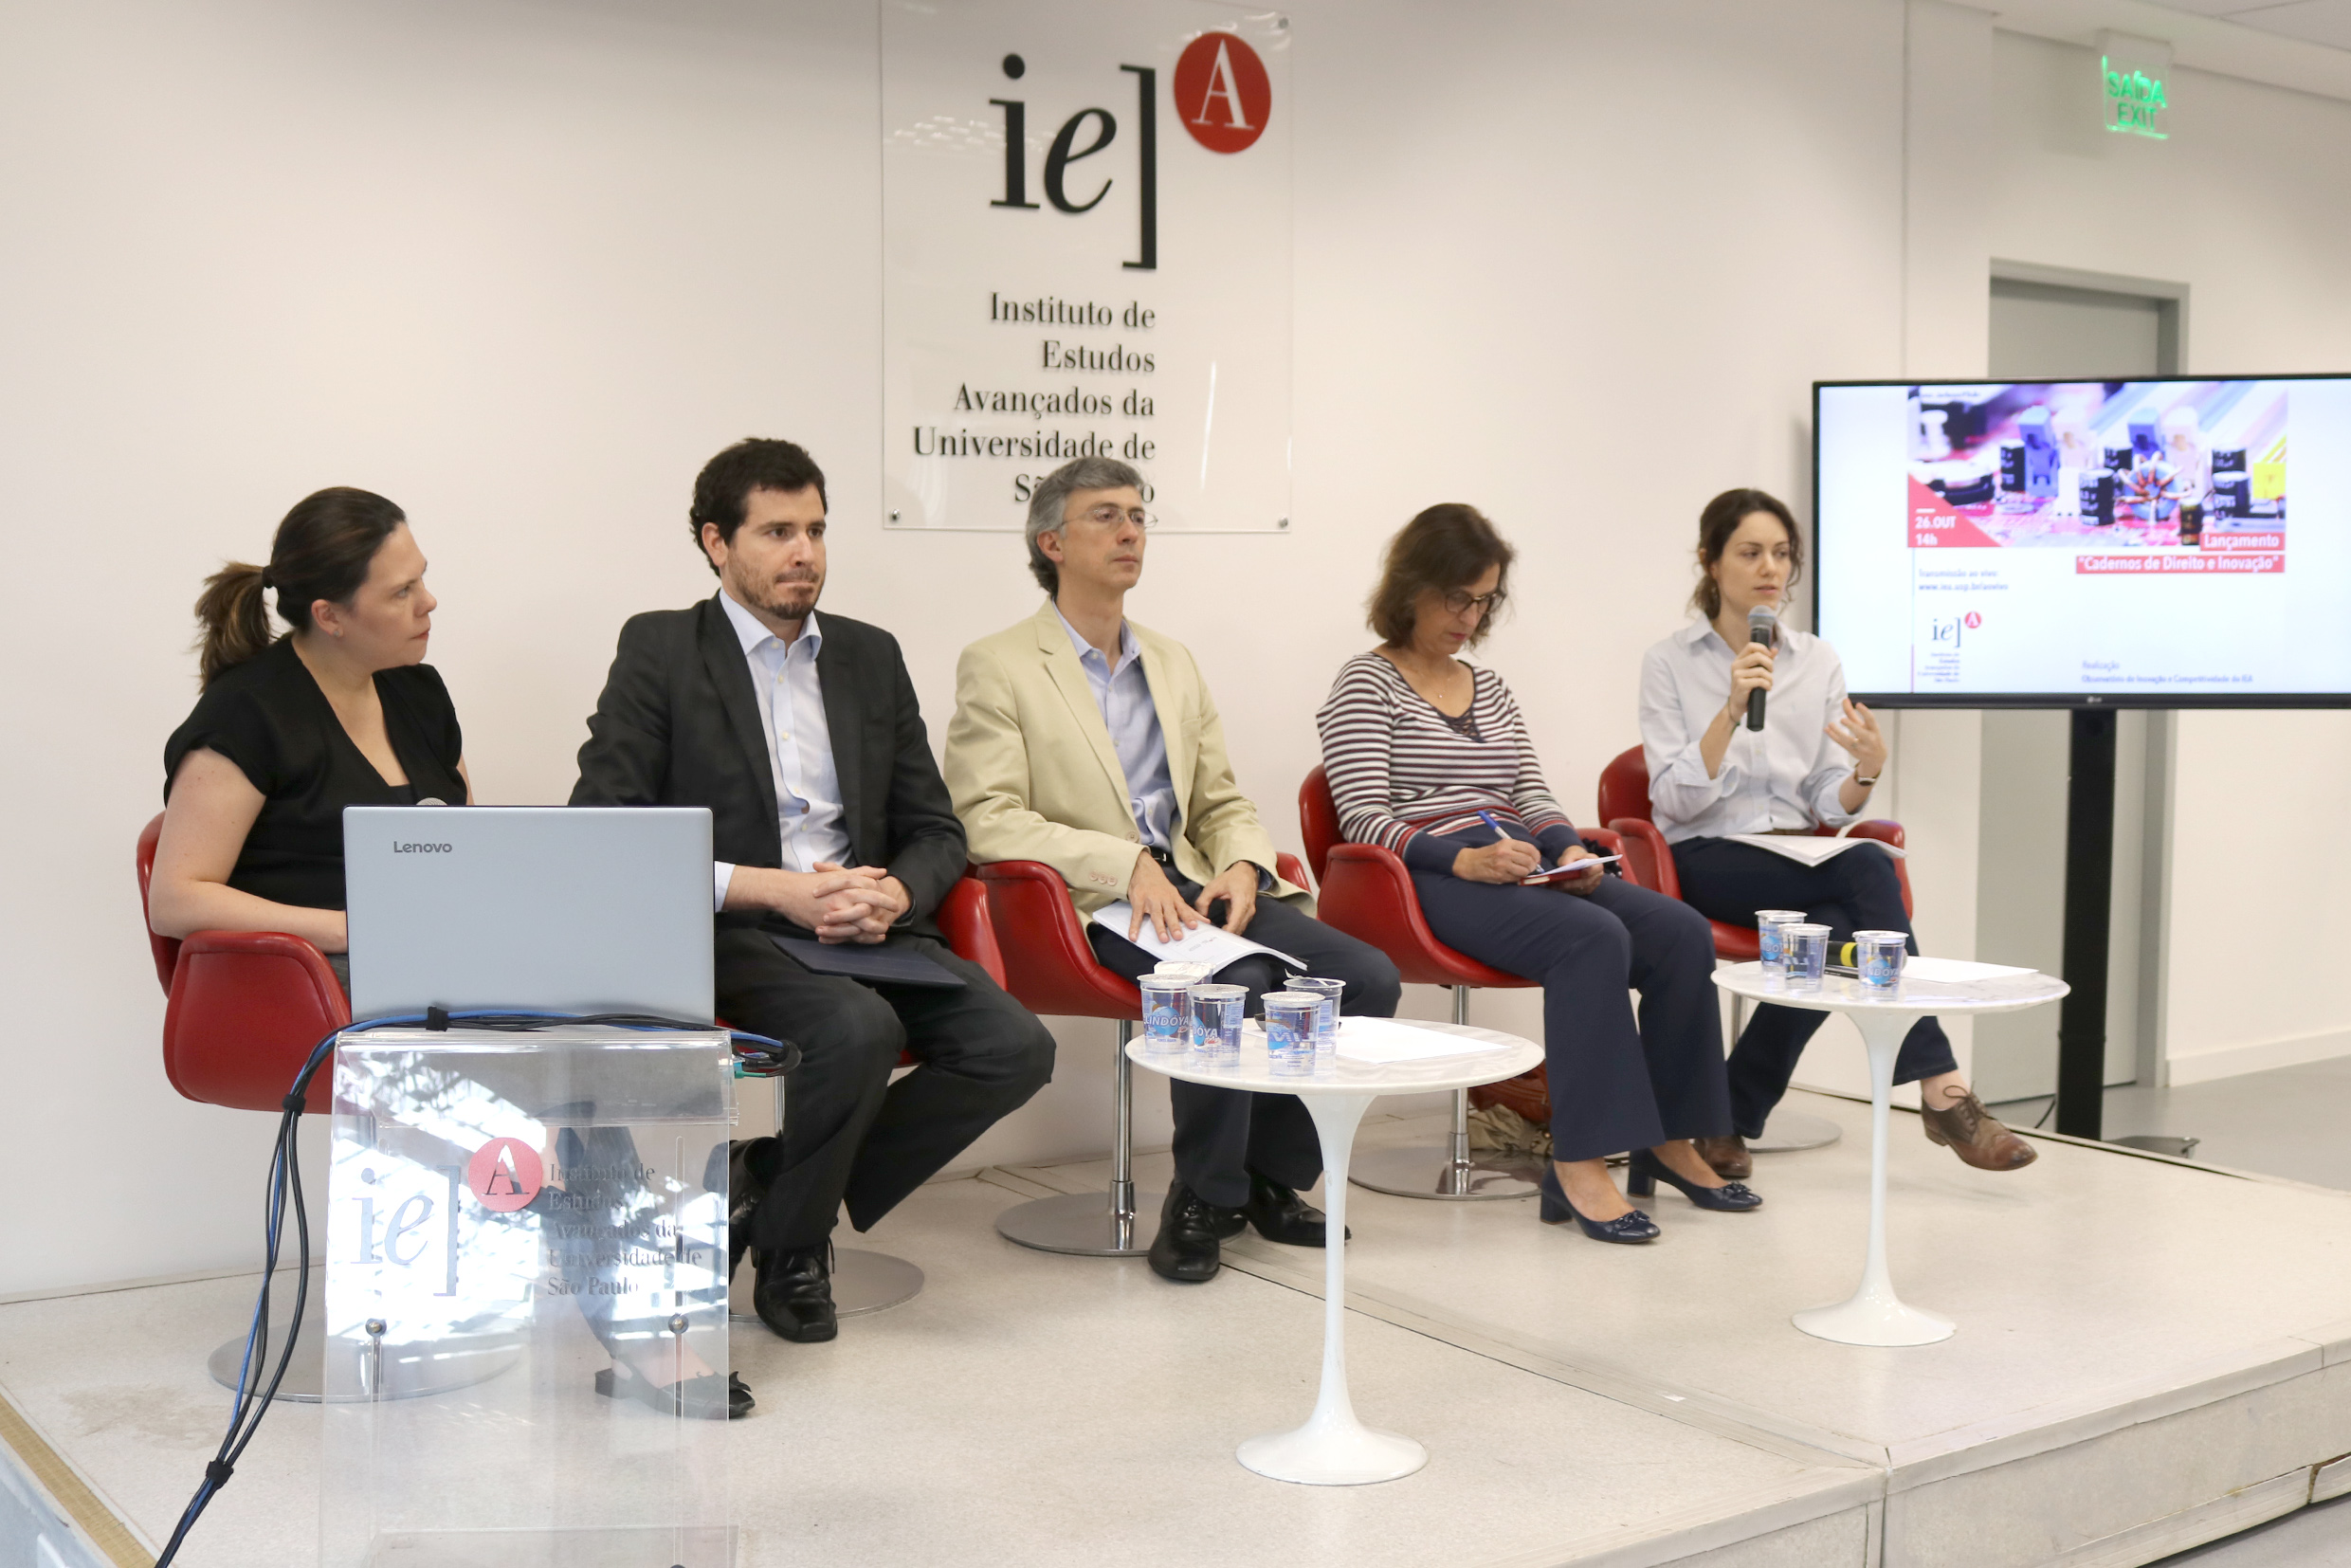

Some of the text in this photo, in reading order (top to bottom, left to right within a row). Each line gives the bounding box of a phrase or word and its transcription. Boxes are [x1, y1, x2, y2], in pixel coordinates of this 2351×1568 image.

[1191, 39, 1255, 130] A
[2118, 101, 2158, 130] EXIT
[991, 291, 1156, 328] Instituto de
[1042, 339, 1156, 372] Estudos
[955, 382, 1155, 420] Avançados da
[913, 426, 1156, 460] Universidade de
[1915, 516, 1957, 529] 26.OUT
[1916, 533, 1939, 546] 14h
[2204, 534, 2279, 551] Lançamento
[2144, 556, 2160, 570] de
[2162, 556, 2205, 570] Direito
[2207, 559, 2215, 570] e
[393, 841, 452, 853] Lenovo
[1144, 1014, 1189, 1027] LINDÓYA
[482, 1143, 530, 1195] A
[634, 1162, 655, 1180] de
[548, 1191, 623, 1211] Estudos
[655, 1219, 679, 1238] da
[549, 1248, 675, 1267] Universidade
[548, 1276, 638, 1296] São Paulo
